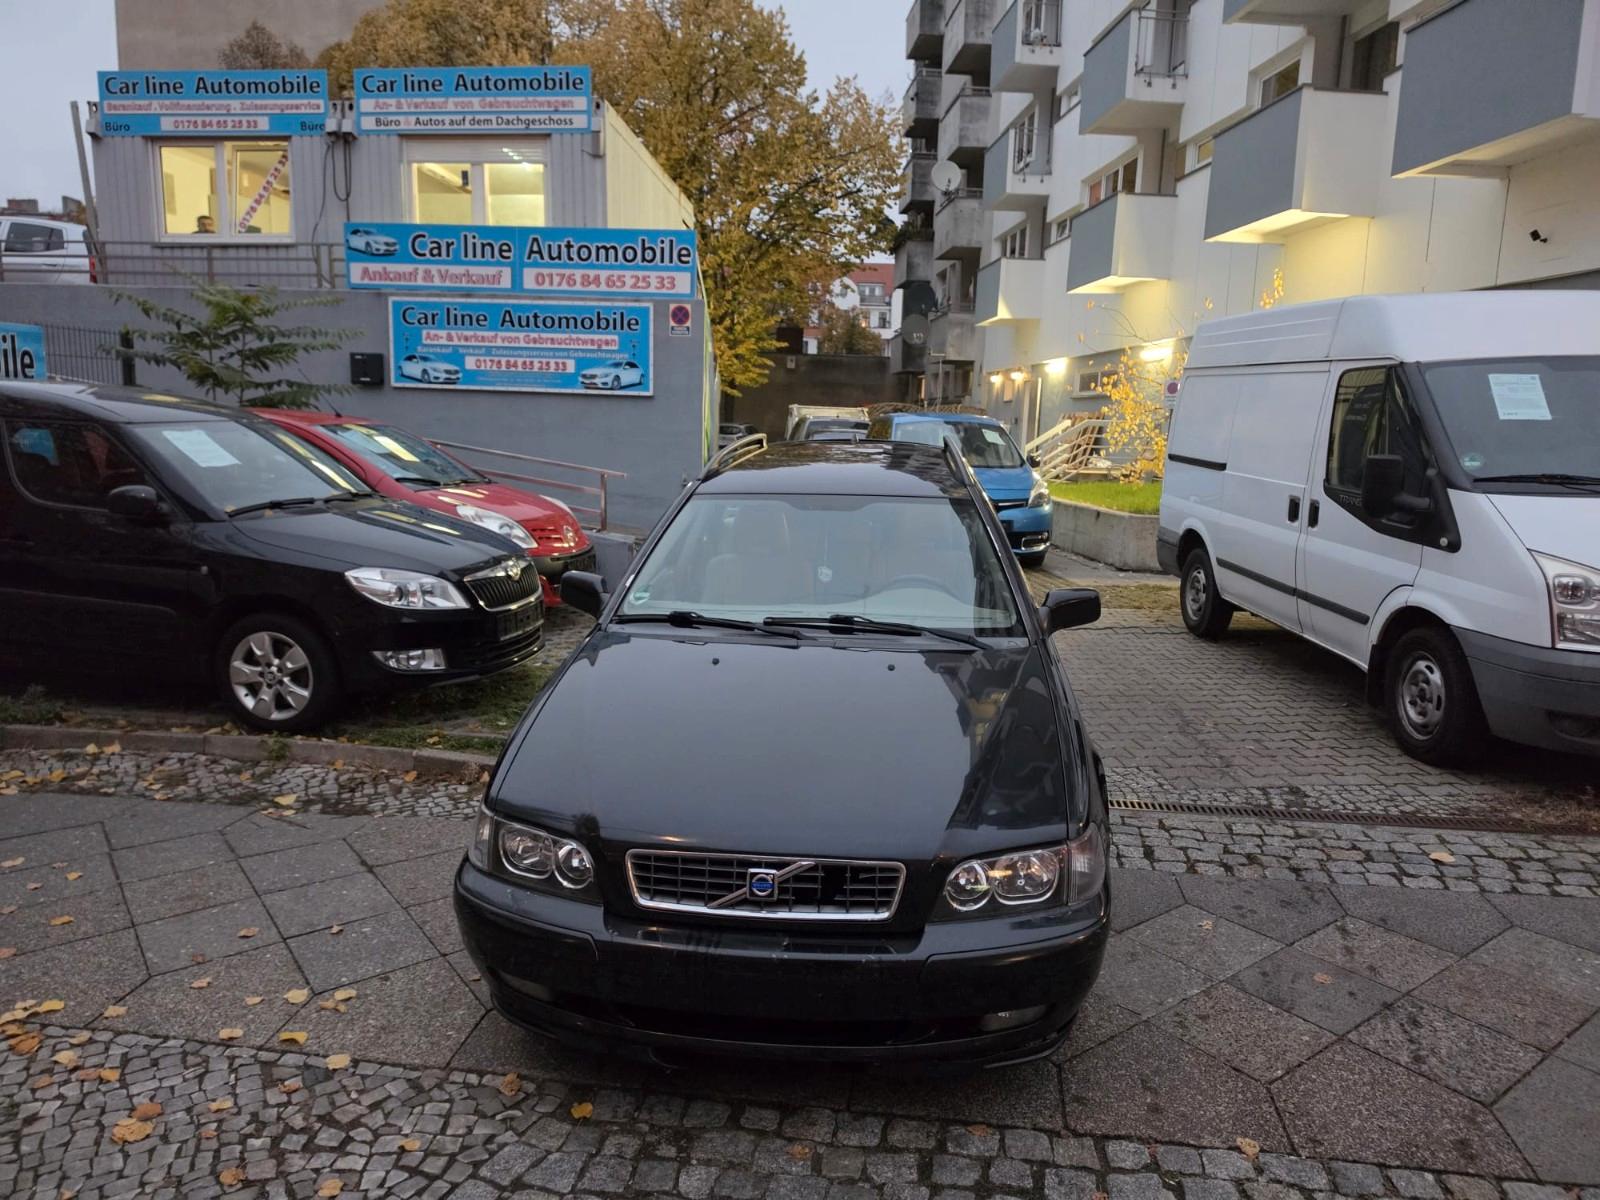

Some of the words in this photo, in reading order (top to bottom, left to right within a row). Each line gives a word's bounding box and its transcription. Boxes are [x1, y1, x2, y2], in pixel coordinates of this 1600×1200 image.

[104, 76, 139, 95] Car
[145, 76, 184, 94] line
[195, 75, 321, 94] Automobile
[361, 75, 397, 93] Car
[404, 74, 443, 93] line
[454, 72, 584, 92] Automobile
[453, 101, 474, 110] von
[479, 98, 575, 111] Gebrauchtwagen
[104, 121, 130, 132] Büro
[173, 120, 198, 130] 0176
[375, 117, 401, 127] Büro
[414, 117, 446, 127] Autos
[448, 116, 466, 126] auf
[469, 116, 493, 126] dem
[496, 116, 574, 129] Dachgeschoss
[409, 233, 456, 259] Car
[462, 233, 513, 260] line
[526, 237, 692, 265] Automobile
[360, 267, 419, 283] Ankauf
[423, 269, 436, 284] &
[438, 269, 504, 286] Verkauf
[534, 272, 576, 287] 0176
[579, 273, 602, 288] 84
[605, 274, 627, 289] 65
[630, 275, 651, 290] 25
[655, 276, 677, 291] 33
[401, 306, 439, 326] Car
[445, 307, 488, 327] line
[500, 309, 641, 332] Automobile
[424, 332, 444, 343] An-
[455, 332, 498, 344] Verkauf
[500, 336, 521, 345] von
[523, 335, 617, 350] Gebrauchtwagen
[0, 332, 35, 379] ile
[475, 359, 502, 370] 0176
[505, 360, 519, 370] 84
[521, 360, 535, 371] 65
[537, 361, 551, 371] 25
[553, 362, 568, 372] 33
